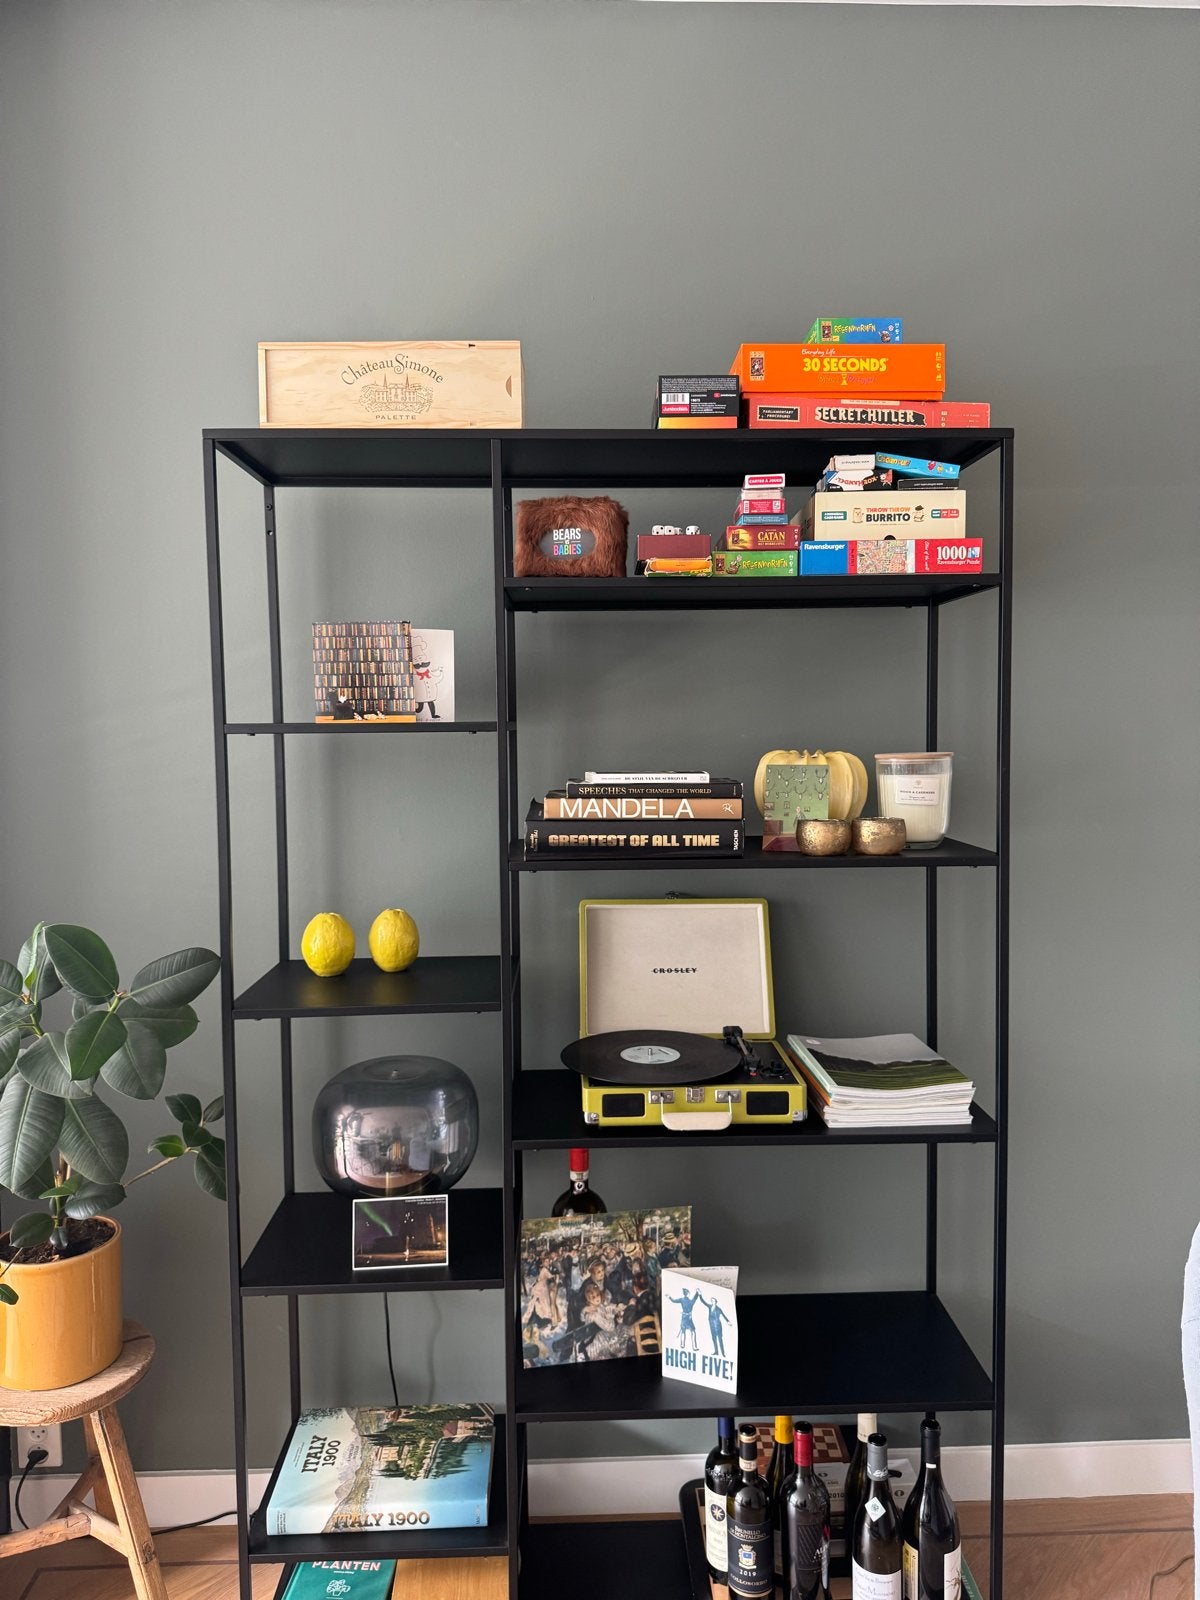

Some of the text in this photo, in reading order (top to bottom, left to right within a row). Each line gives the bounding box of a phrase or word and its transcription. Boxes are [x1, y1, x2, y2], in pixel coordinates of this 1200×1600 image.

[341, 353, 445, 386] Château Simone
[803, 357, 887, 372] 30 SECONDS
[815, 406, 915, 423] SECRET HITLER
[866, 513, 911, 522] BURRITO
[553, 528, 581, 541] BEARS
[757, 531, 785, 541] CATAN
[553, 543, 582, 556] BABIES
[804, 543, 846, 551] Ravensburger
[937, 545, 967, 560] 1000
[578, 786, 627, 795] SPEECHES
[559, 798, 695, 819] MANDELA
[548, 834, 627, 847] GREATEST
[629, 834, 648, 847] OF
[652, 834, 680, 847] ALL
[682, 834, 720, 847] TIME
[665, 1347, 734, 1381] HIGH FIVE!
[301, 1435, 328, 1473] ITALY
[321, 1440, 341, 1467] 1900
[333, 1510, 431, 1529] ITALY 1900
[312, 1560, 381, 1571] PLANTEN
[739, 1569, 757, 1577] 2019
